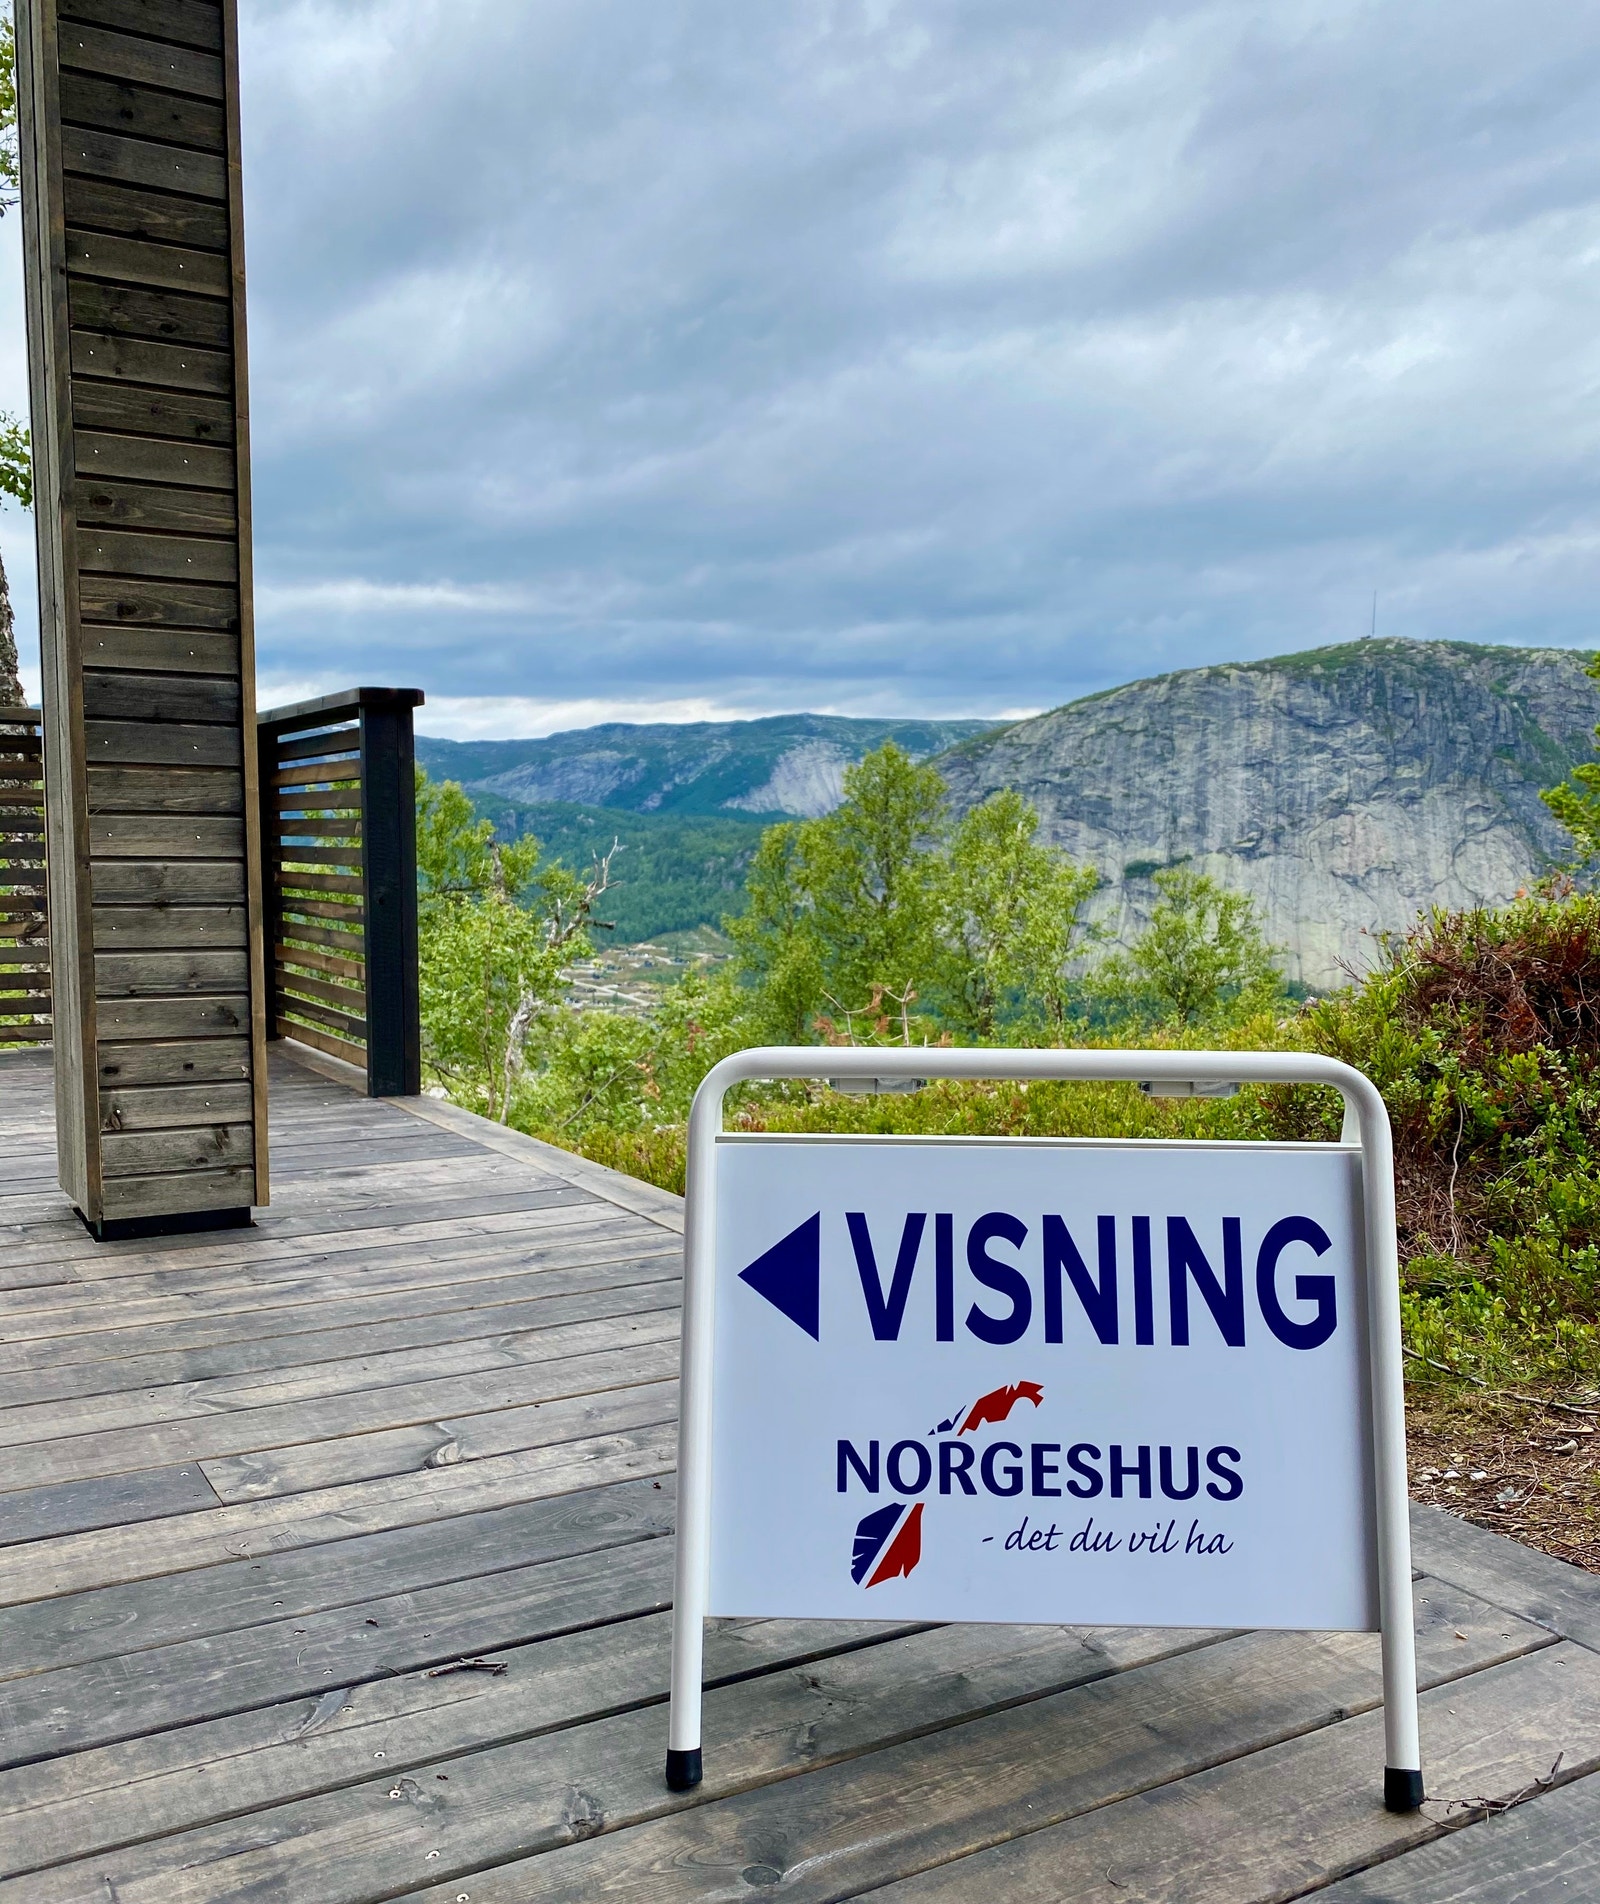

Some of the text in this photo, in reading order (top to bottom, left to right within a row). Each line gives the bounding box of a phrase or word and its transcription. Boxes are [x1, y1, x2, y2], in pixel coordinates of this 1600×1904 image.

[844, 1210, 1338, 1351] VISNING
[836, 1439, 1244, 1502] NORGESHUS
[1004, 1515, 1064, 1552] det
[1069, 1517, 1123, 1553] du
[1128, 1519, 1180, 1554] vil
[1185, 1518, 1234, 1555] ha
